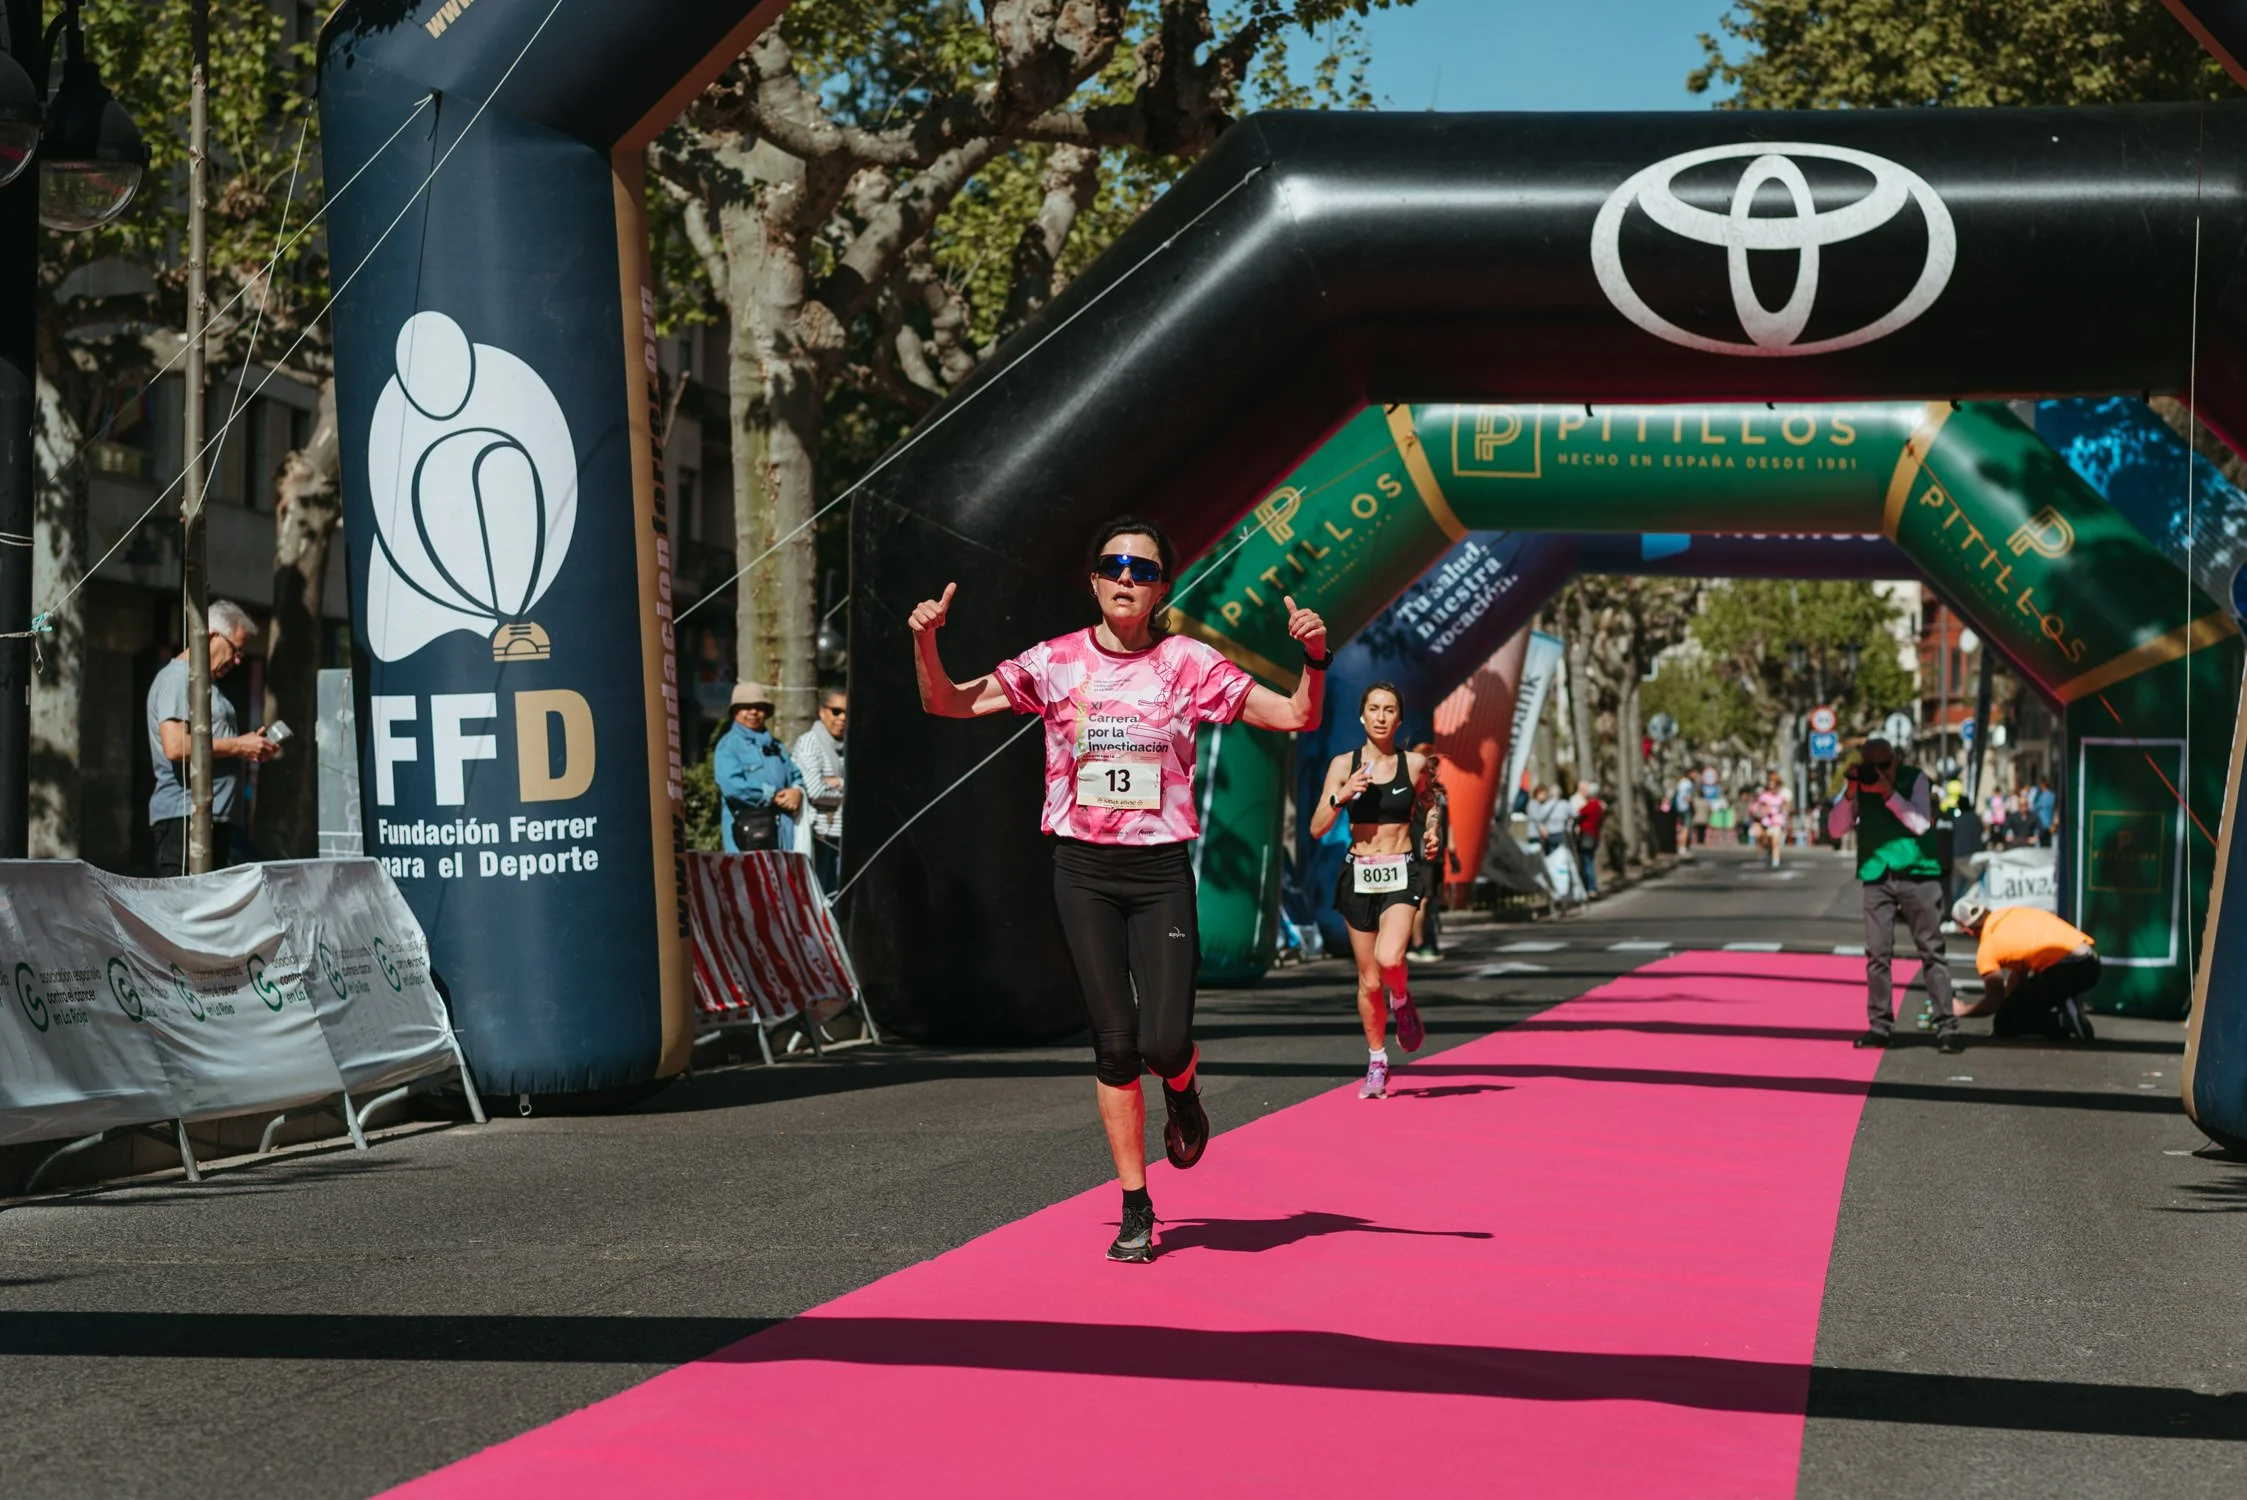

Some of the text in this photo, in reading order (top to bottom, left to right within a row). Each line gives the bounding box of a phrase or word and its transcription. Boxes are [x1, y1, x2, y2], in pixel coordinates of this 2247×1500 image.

[1557, 406, 1857, 445] PITILLOS
[1558, 452, 1857, 471] HECHO EN ESPAÑA DESDE 1981
[1221, 473, 1403, 628] PITILLOS
[1397, 540, 1491, 625] Tu salud,
[1919, 485, 2087, 663] PITILLOS
[1416, 556, 1502, 640] nuestra
[1430, 573, 1519, 655] vocación.
[1087, 727, 1125, 740] por la
[1088, 713, 1138, 724] Carrera
[371, 689, 597, 806] FFD
[1088, 741, 1169, 753] Investigación
[1105, 769, 1131, 793] 13
[378, 815, 598, 845] Fundación Ferrer
[438, 852, 463, 878] el
[479, 846, 600, 881] Deporte
[1363, 867, 1398, 883] 8031
[46, 989, 68, 1005] contra
[74, 986, 96, 1003] cáncer
[53, 1013, 63, 1026] en
